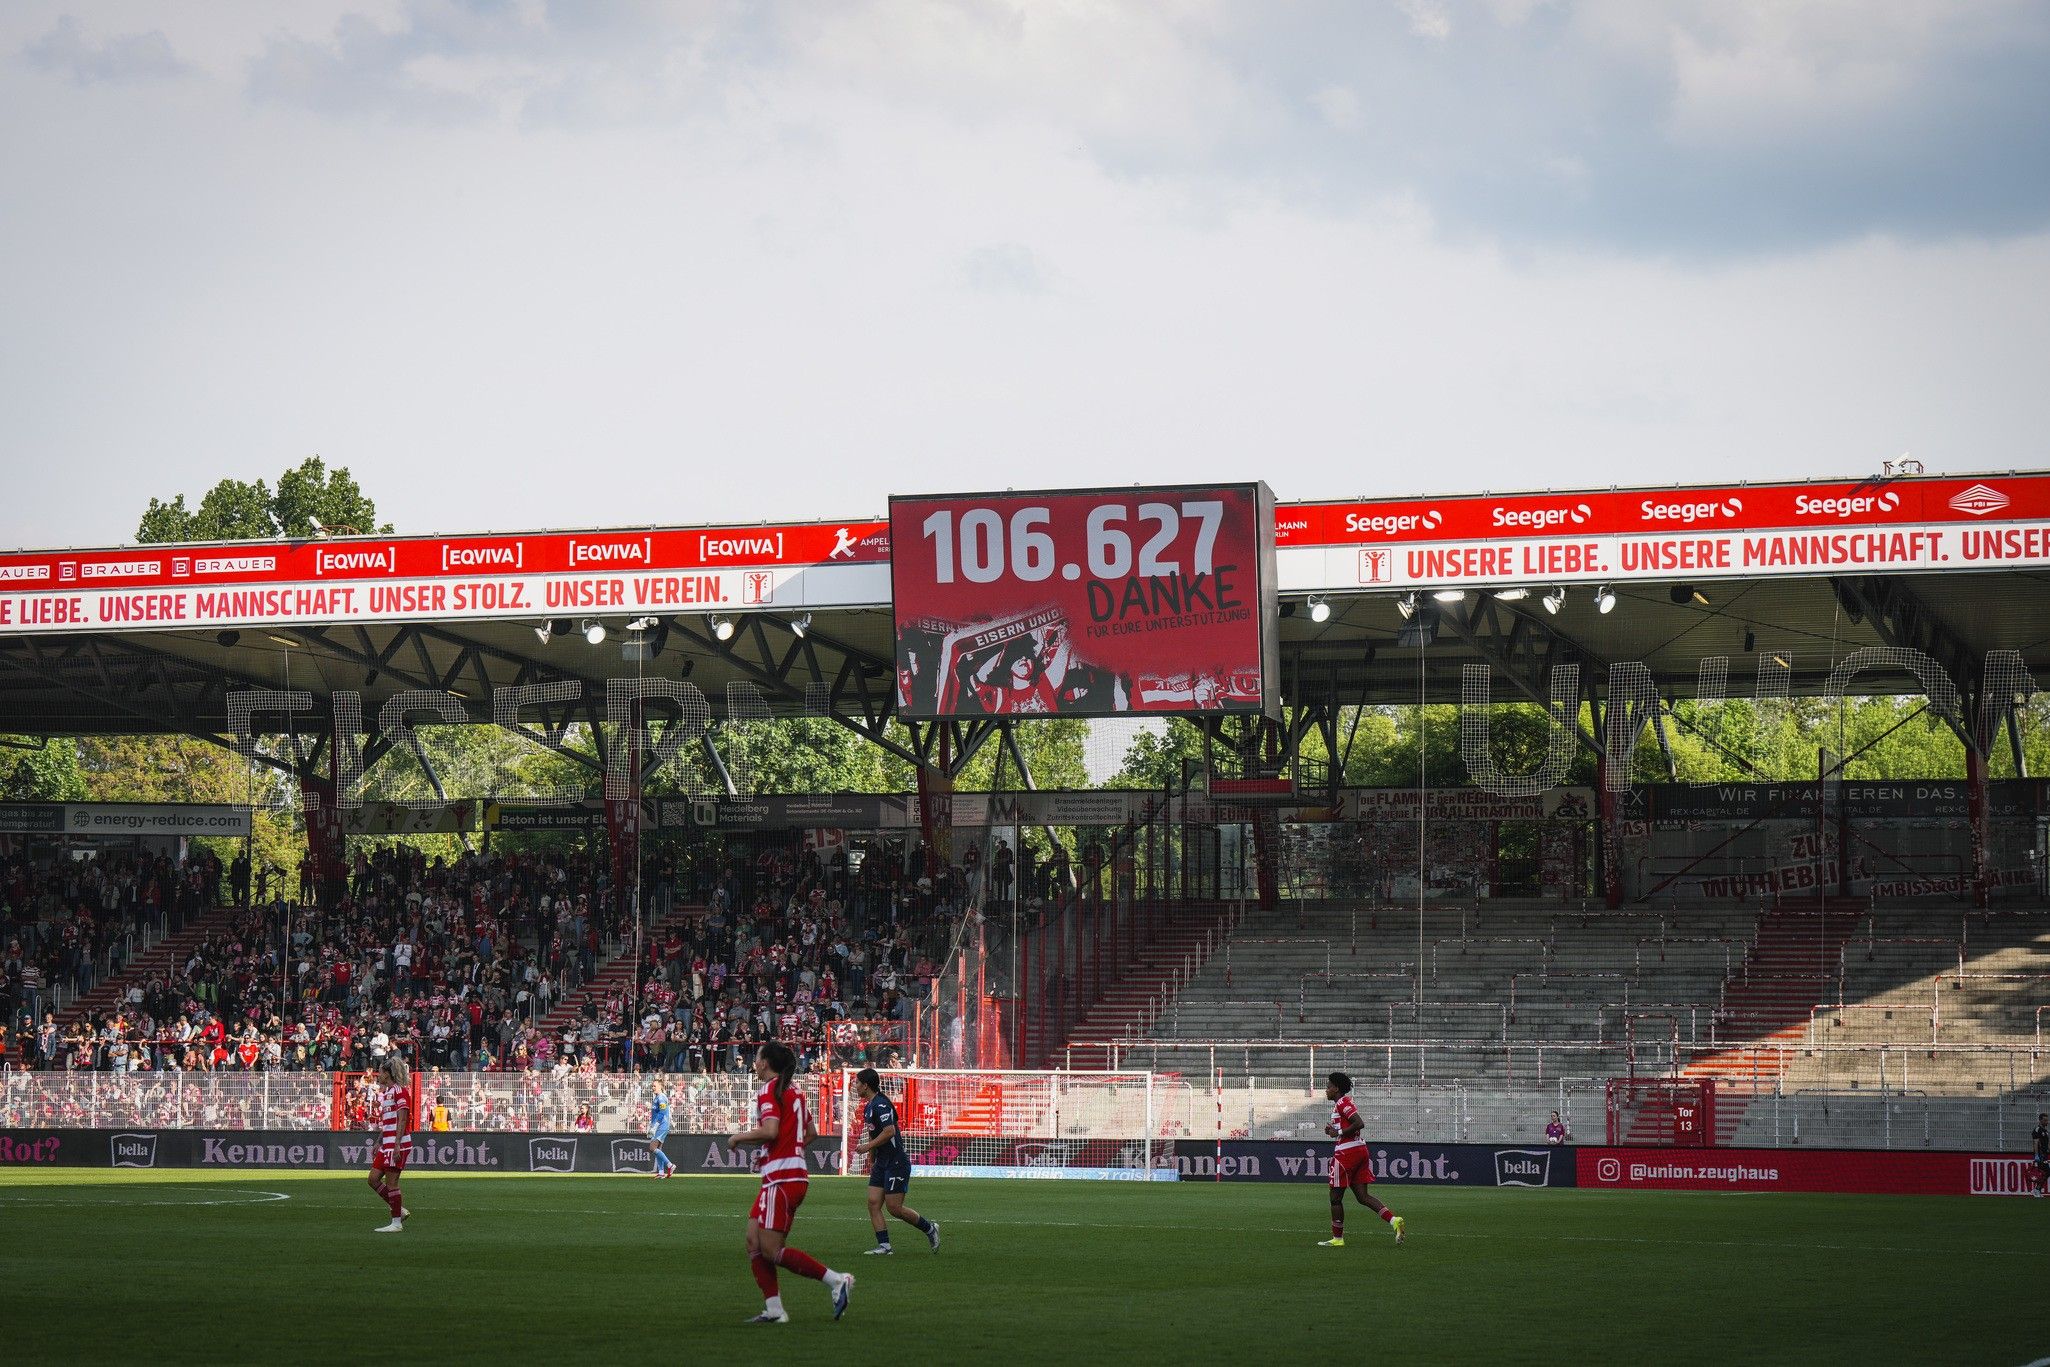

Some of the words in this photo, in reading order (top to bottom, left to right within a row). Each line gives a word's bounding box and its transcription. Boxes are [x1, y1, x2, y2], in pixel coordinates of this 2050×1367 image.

[1641, 500, 1718, 522] Seeger
[1795, 494, 1875, 517] Seeger
[1345, 513, 1420, 534] Seeger
[1493, 508, 1568, 529] Seeger
[923, 501, 1223, 583] 106.627
[1407, 548, 1513, 578] UNSERE
[1523, 544, 1608, 574] LIEBE.
[1621, 539, 1731, 571] UNSERE
[1743, 532, 1949, 567] MANNSCHAFT.
[83, 562, 160, 576] BRAUER
[196, 558, 275, 573] BRAUER
[20, 597, 88, 624] LIEBE.
[99, 594, 186, 622] UNSERE
[196, 588, 359, 618] MANNSCHAFT.
[370, 585, 446, 612] UNSER
[453, 582, 531, 610] STOLZ.
[545, 578, 624, 607] UNSER
[634, 575, 728, 605] VEREIN.
[1086, 565, 1242, 622] DANKE
[975, 622, 1026, 647] EISERN
[1113, 620, 1142, 635] EURE
[1917, 785, 1963, 799] DAS.
[720, 804, 769, 816] Heidelberg
[93, 813, 242, 828] energy-reduce.com
[501, 814, 536, 825] Beton
[538, 814, 554, 825] ist
[556, 815, 590, 825] unser
[719, 813, 763, 823] Materials
[923, 1105, 936, 1114] Tor
[1678, 1107, 1694, 1118] Tor
[1680, 1121, 1692, 1132] 13
[118, 1142, 149, 1158] bella
[202, 1138, 325, 1164] Kennen
[338, 1138, 378, 1164] wi
[536, 1146, 568, 1161] bella
[619, 1147, 651, 1162] bella
[1504, 1159, 1541, 1175] bella
[1630, 1163, 1779, 1182] @union.zeughaus
[889, 1176, 896, 1191] 7
